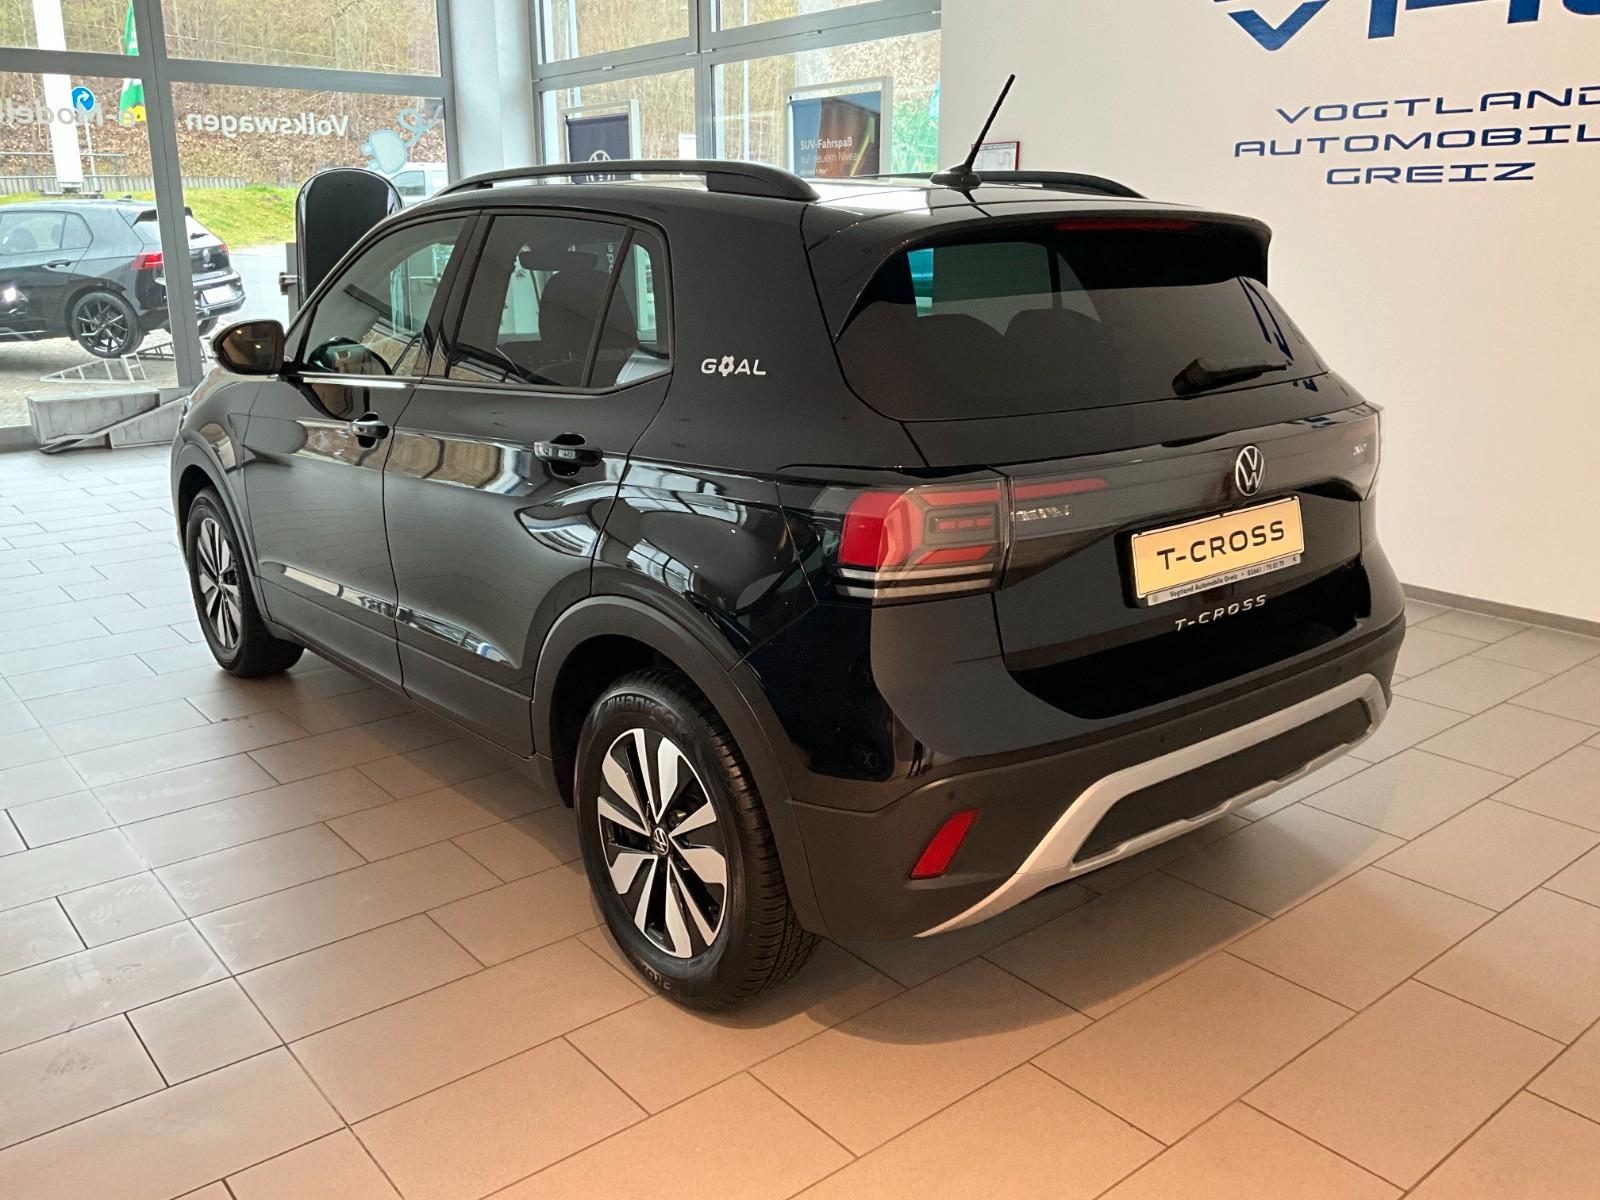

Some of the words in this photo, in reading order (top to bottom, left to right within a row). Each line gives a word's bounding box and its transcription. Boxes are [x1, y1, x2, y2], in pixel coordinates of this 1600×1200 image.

[1326, 162, 1536, 185] GREIZ
[701, 355, 767, 377] GOAL
[1156, 520, 1285, 570] T-CROSS
[1175, 594, 1267, 631] T-CROSS
